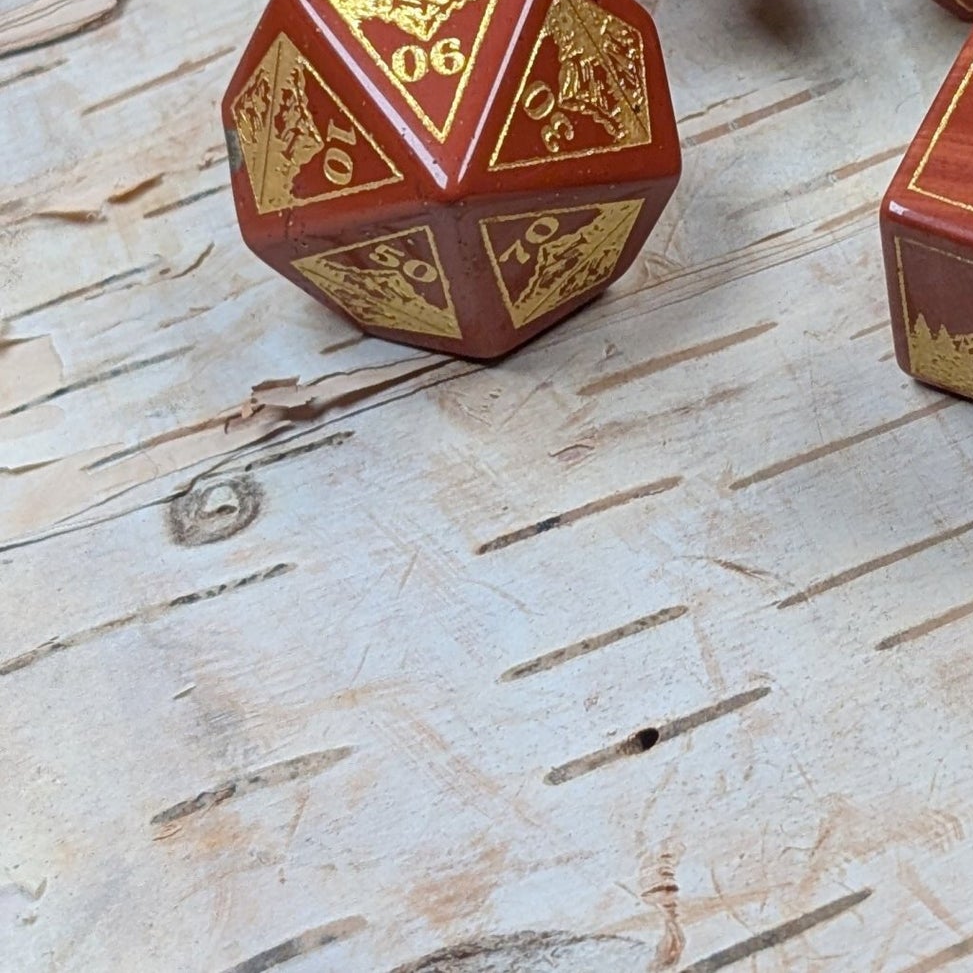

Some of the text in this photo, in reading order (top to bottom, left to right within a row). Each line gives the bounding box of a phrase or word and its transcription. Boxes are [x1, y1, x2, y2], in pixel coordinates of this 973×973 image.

[391, 36, 466, 83] 90
[524, 80, 575, 153] 30
[322, 119, 358, 186] 10
[369, 243, 438, 284] 50
[499, 216, 559, 267] 70
